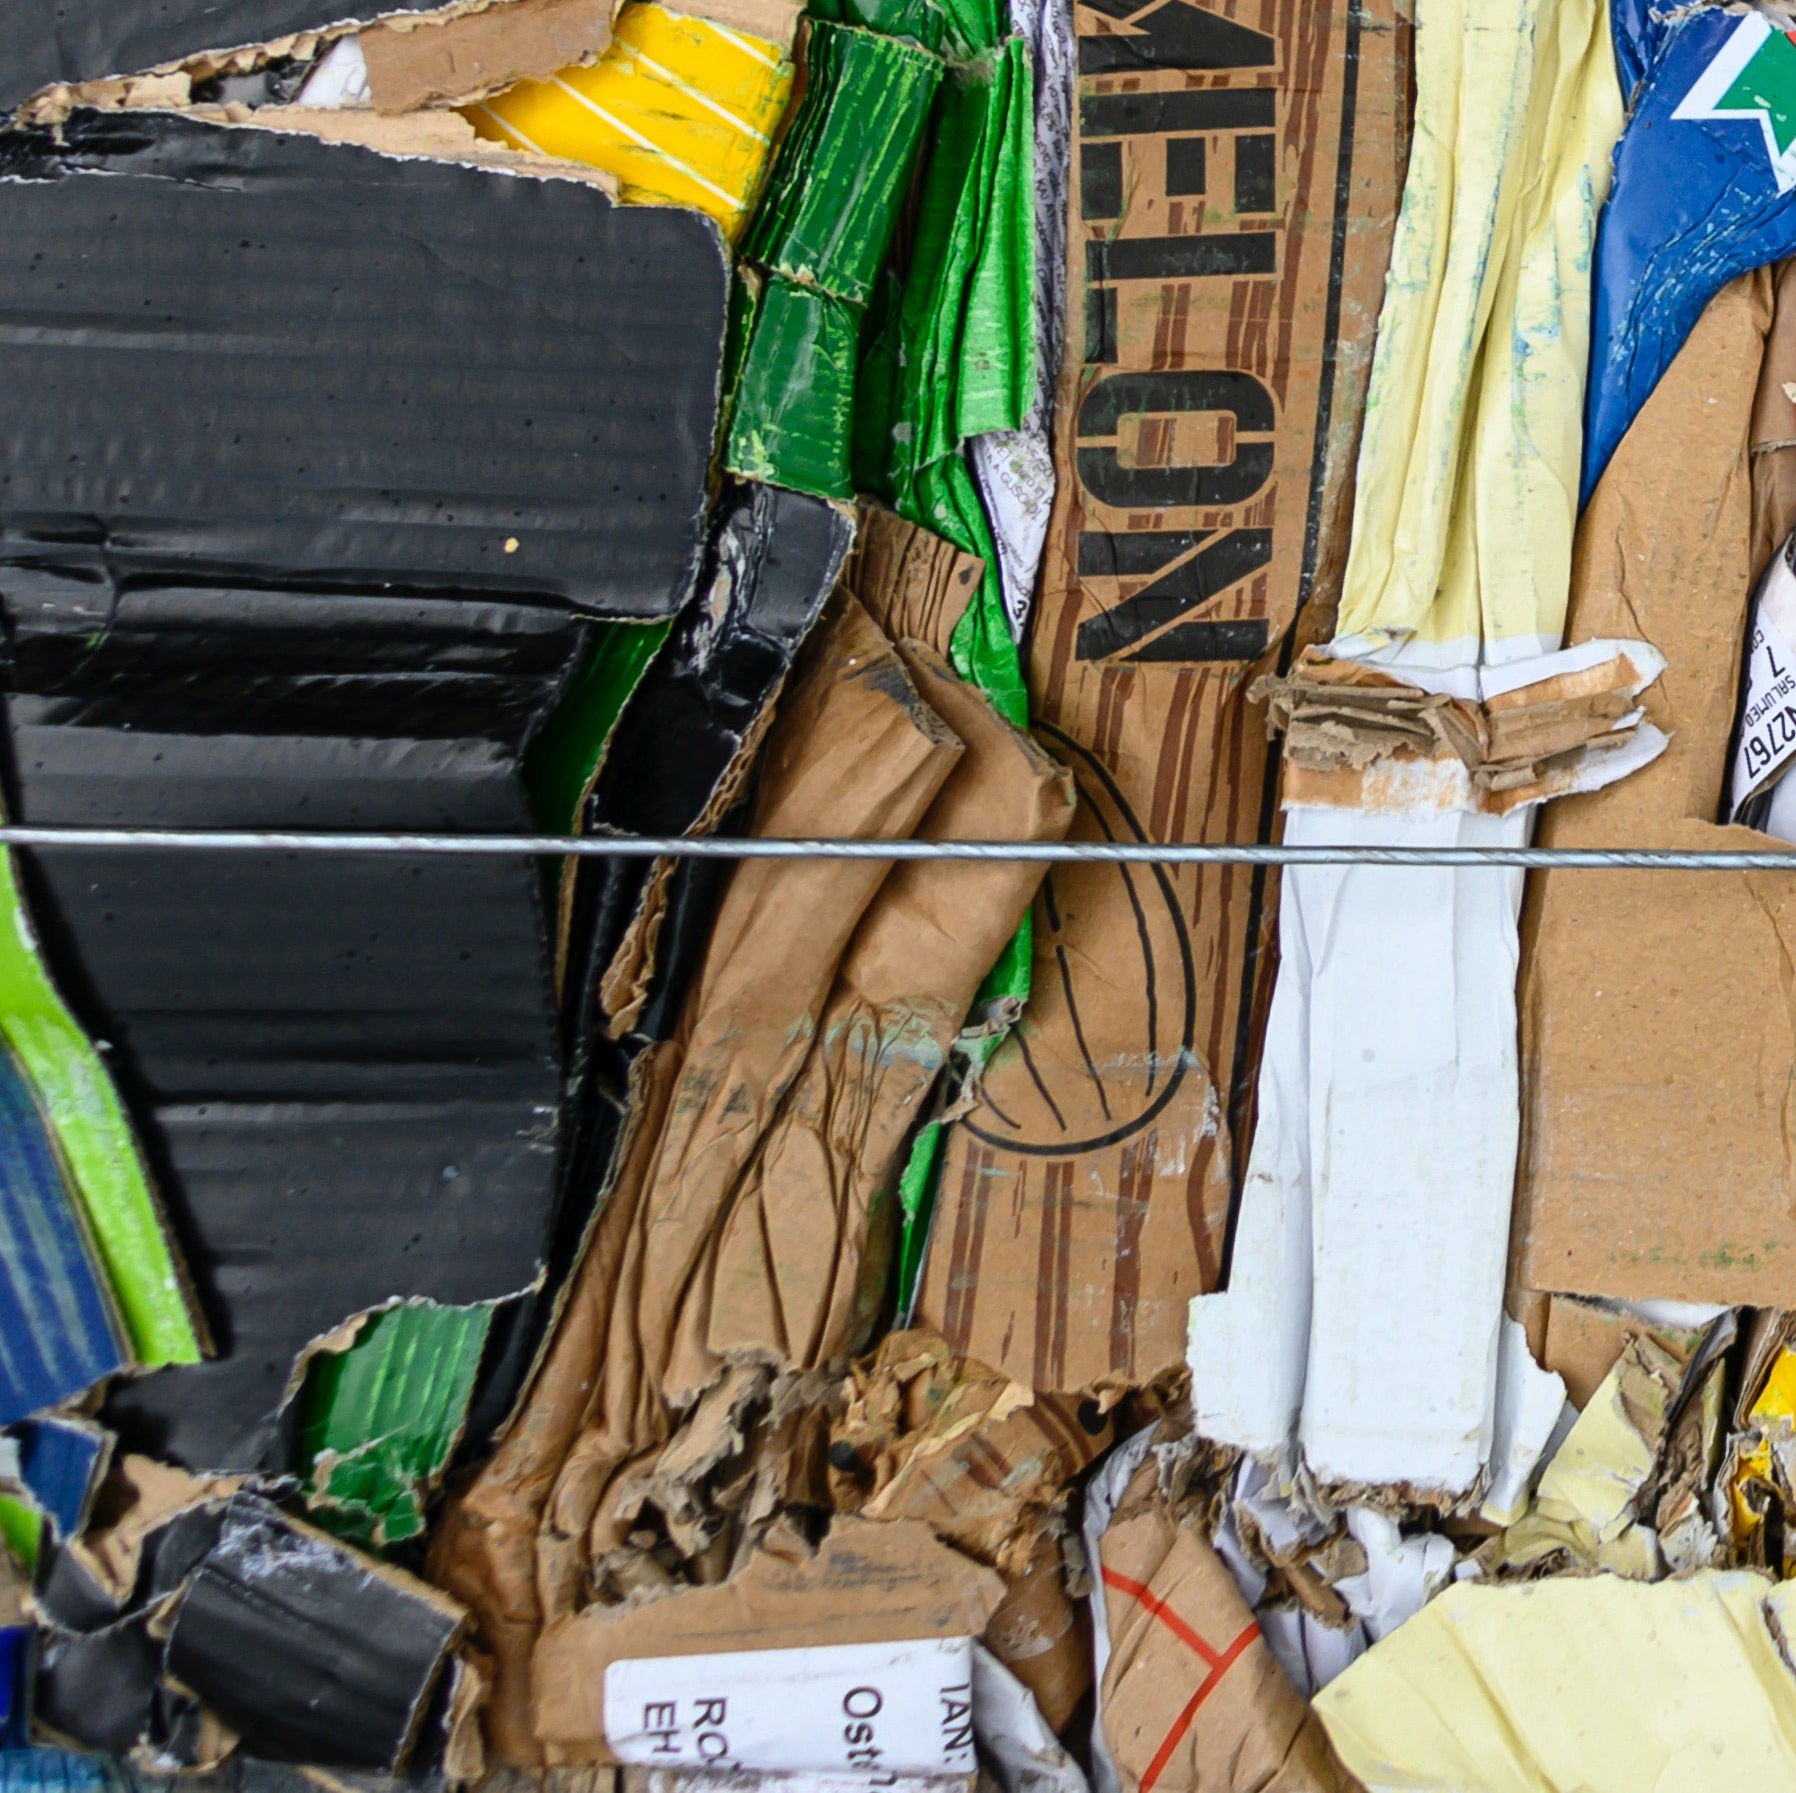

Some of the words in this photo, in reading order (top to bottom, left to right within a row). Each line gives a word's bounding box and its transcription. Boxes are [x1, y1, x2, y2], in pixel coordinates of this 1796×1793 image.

[1765, 645, 1787, 679] 7
[692, 1695, 744, 1771] RO
[939, 1681, 975, 1765] IAN:
